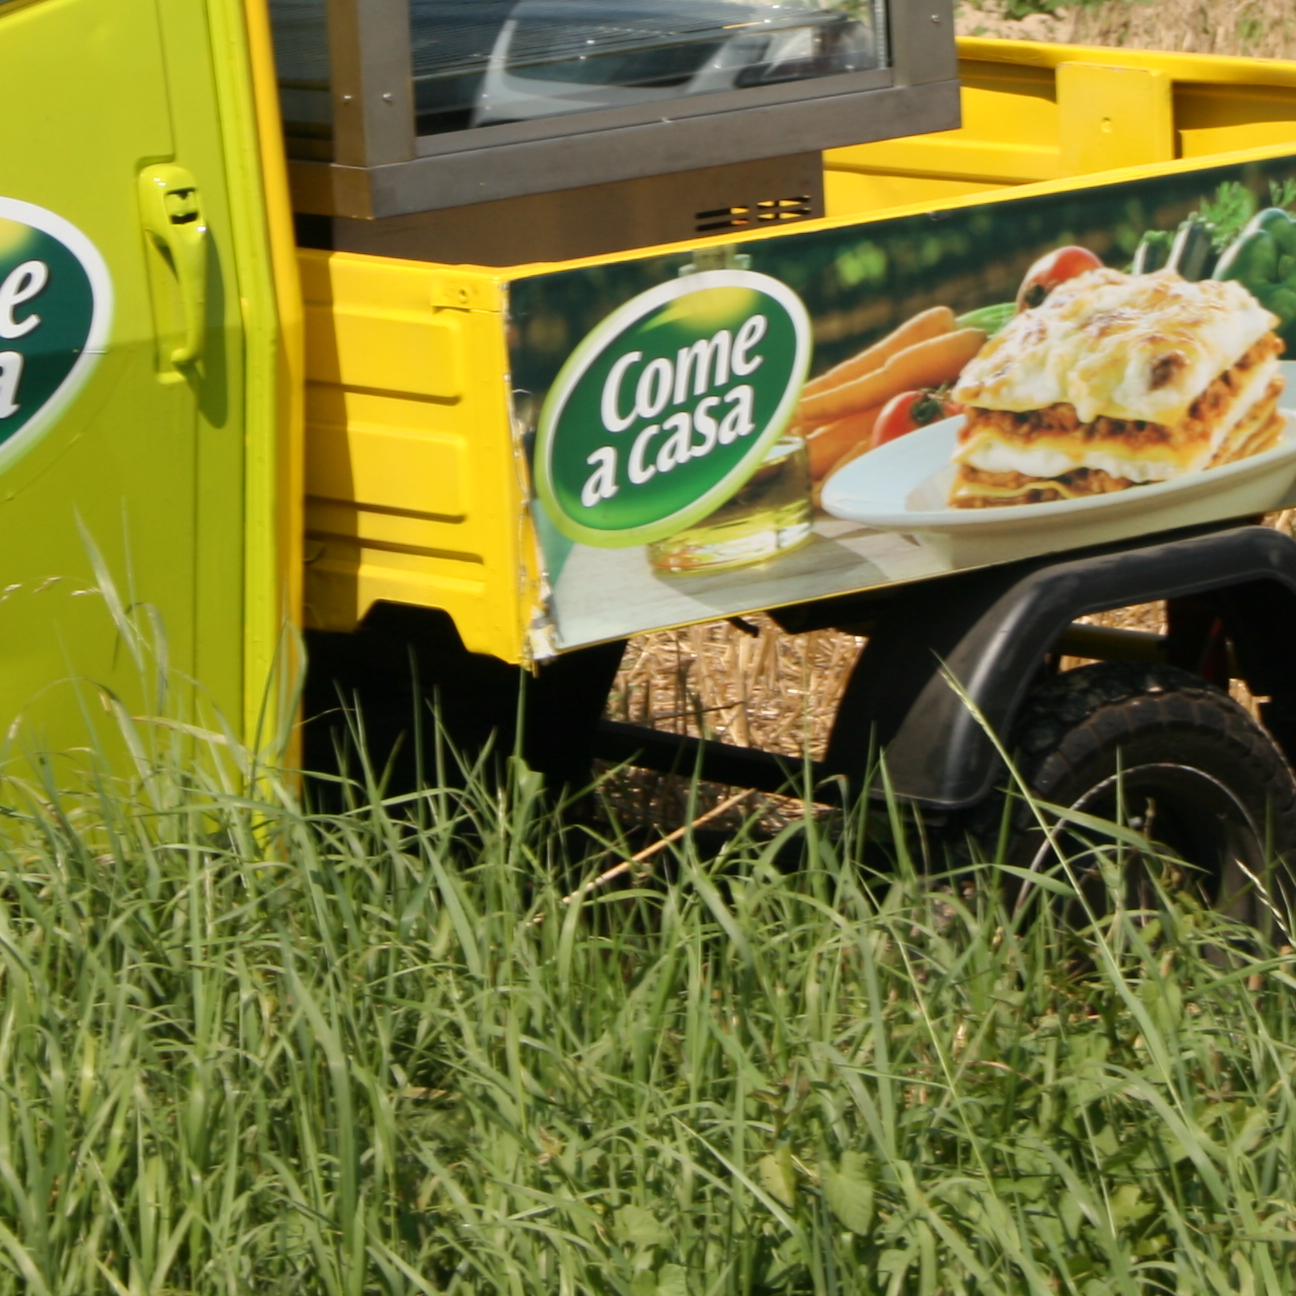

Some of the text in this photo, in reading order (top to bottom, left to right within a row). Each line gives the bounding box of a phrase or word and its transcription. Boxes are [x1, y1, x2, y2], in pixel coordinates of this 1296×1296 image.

[601, 314, 768, 432] Come
[581, 384, 756, 508] a casa
